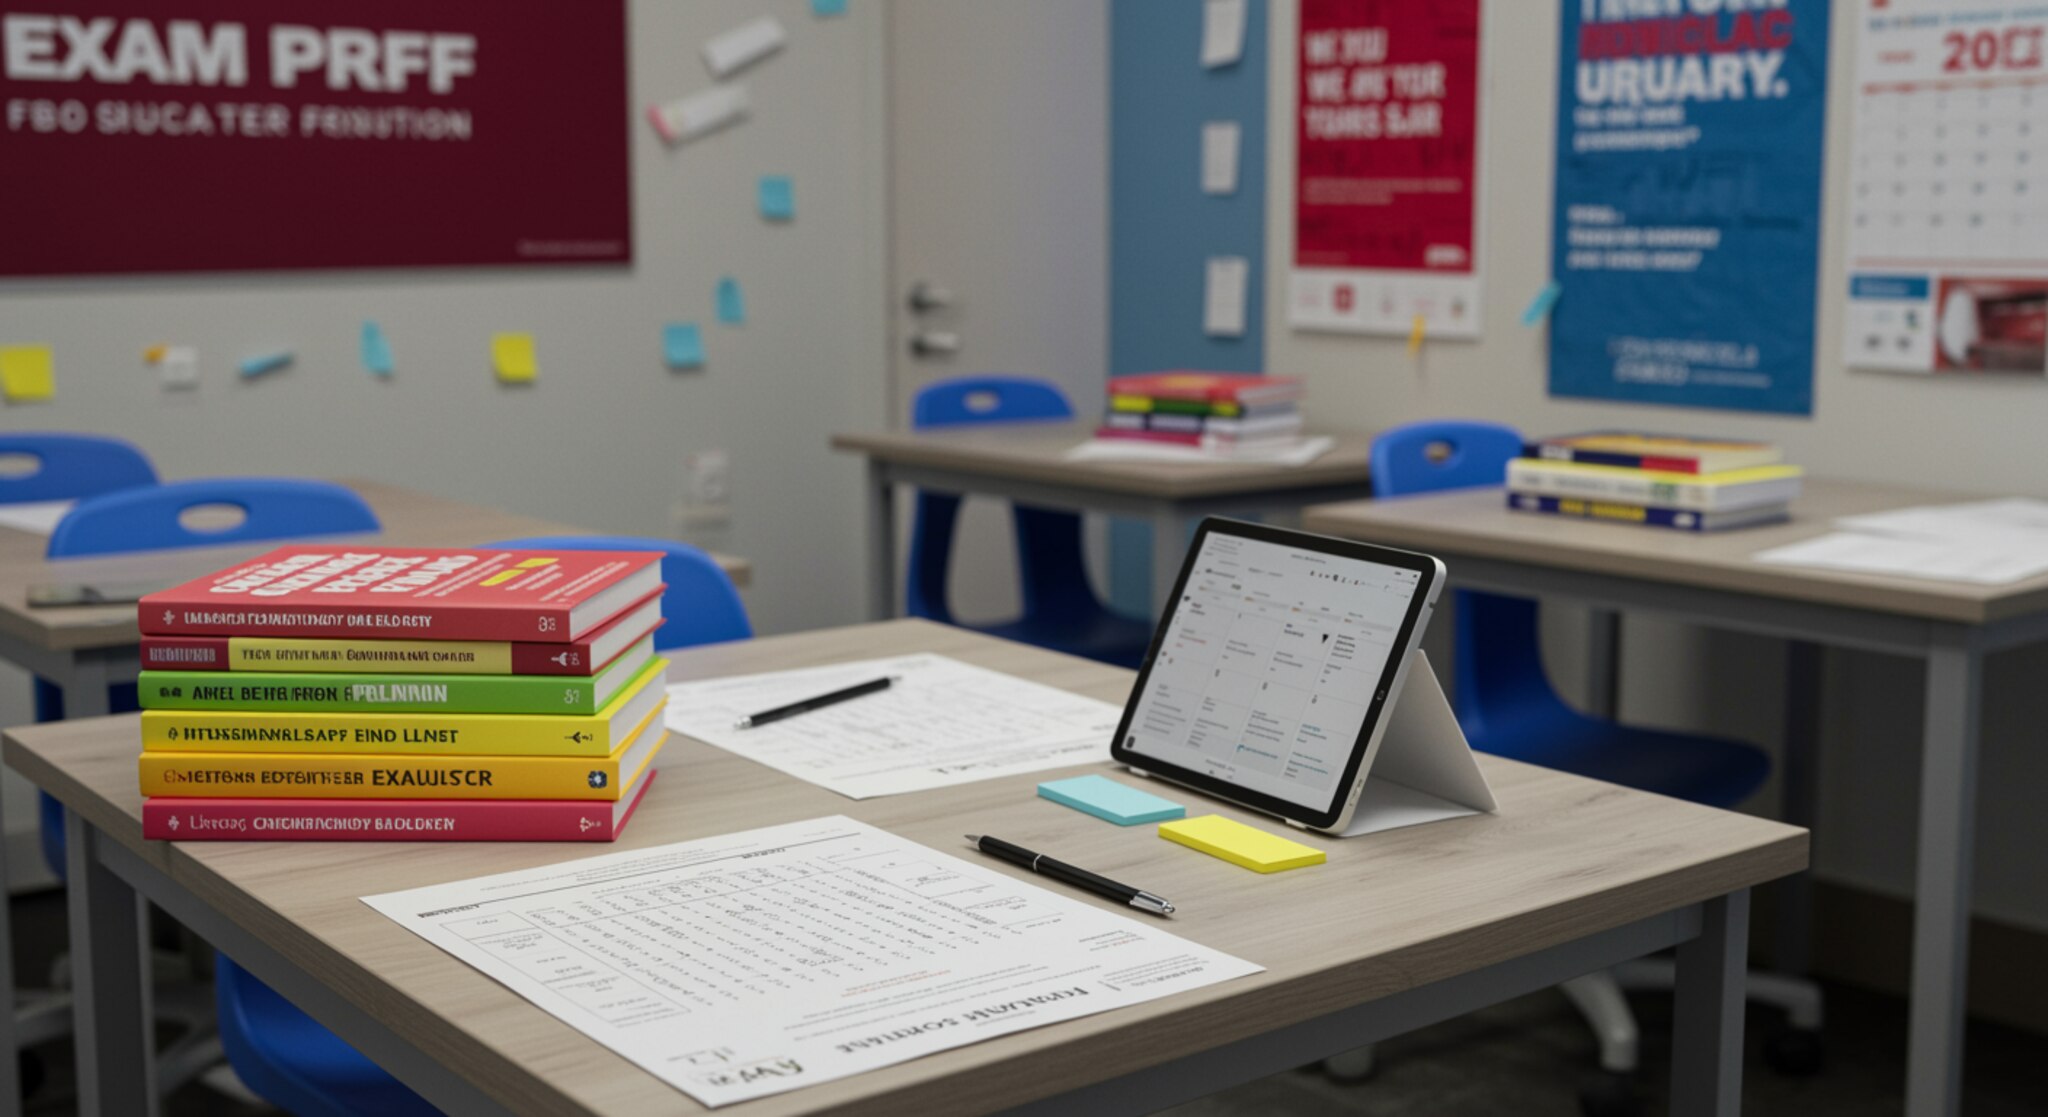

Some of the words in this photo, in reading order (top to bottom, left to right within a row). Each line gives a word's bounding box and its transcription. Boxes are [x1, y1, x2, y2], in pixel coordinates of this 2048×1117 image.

[3, 13, 248, 86] EXAM
[268, 24, 477, 94] PRFF
[1576, 51, 1790, 106] URUARY.
